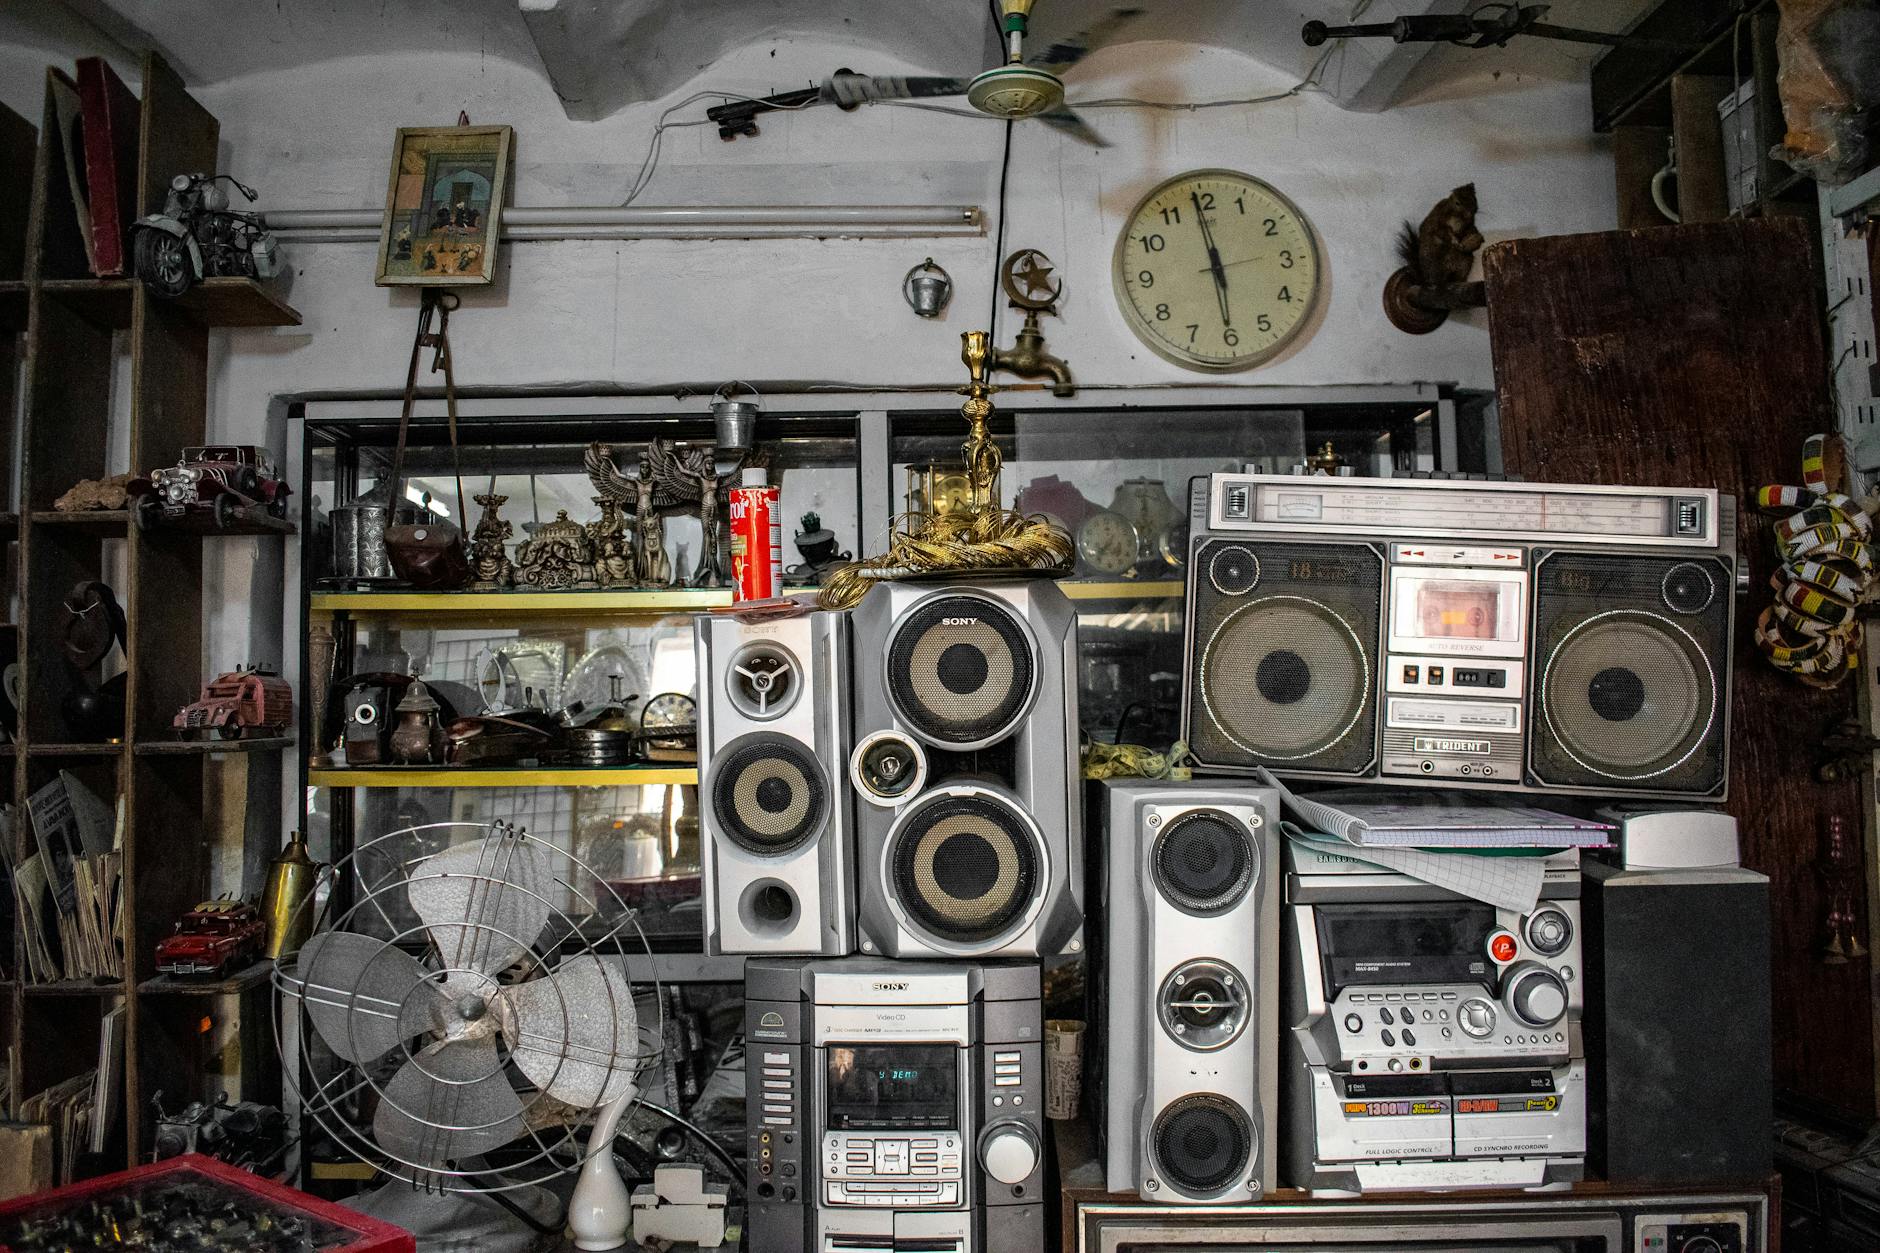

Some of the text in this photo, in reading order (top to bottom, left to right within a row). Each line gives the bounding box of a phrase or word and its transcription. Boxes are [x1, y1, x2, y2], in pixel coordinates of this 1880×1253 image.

[1234, 197, 1245, 214] 1
[1159, 206, 1181, 225] 11
[1262, 218, 1278, 236] 2
[1138, 234, 1165, 253] 10
[1279, 250, 1294, 269] 3
[1138, 270, 1154, 288] 9
[1277, 285, 1292, 303] 4
[1155, 303, 1171, 321] 8
[1257, 314, 1271, 332] 5
[1186, 324, 1199, 343] 7
[1223, 328, 1239, 347] 6
[942, 617, 977, 626] SONY
[1436, 741, 1482, 751] TRIDENT
[872, 983, 909, 991] SONY
[1545, 1079, 1551, 1087] 2
[1366, 1102, 1410, 1115] 1300W
